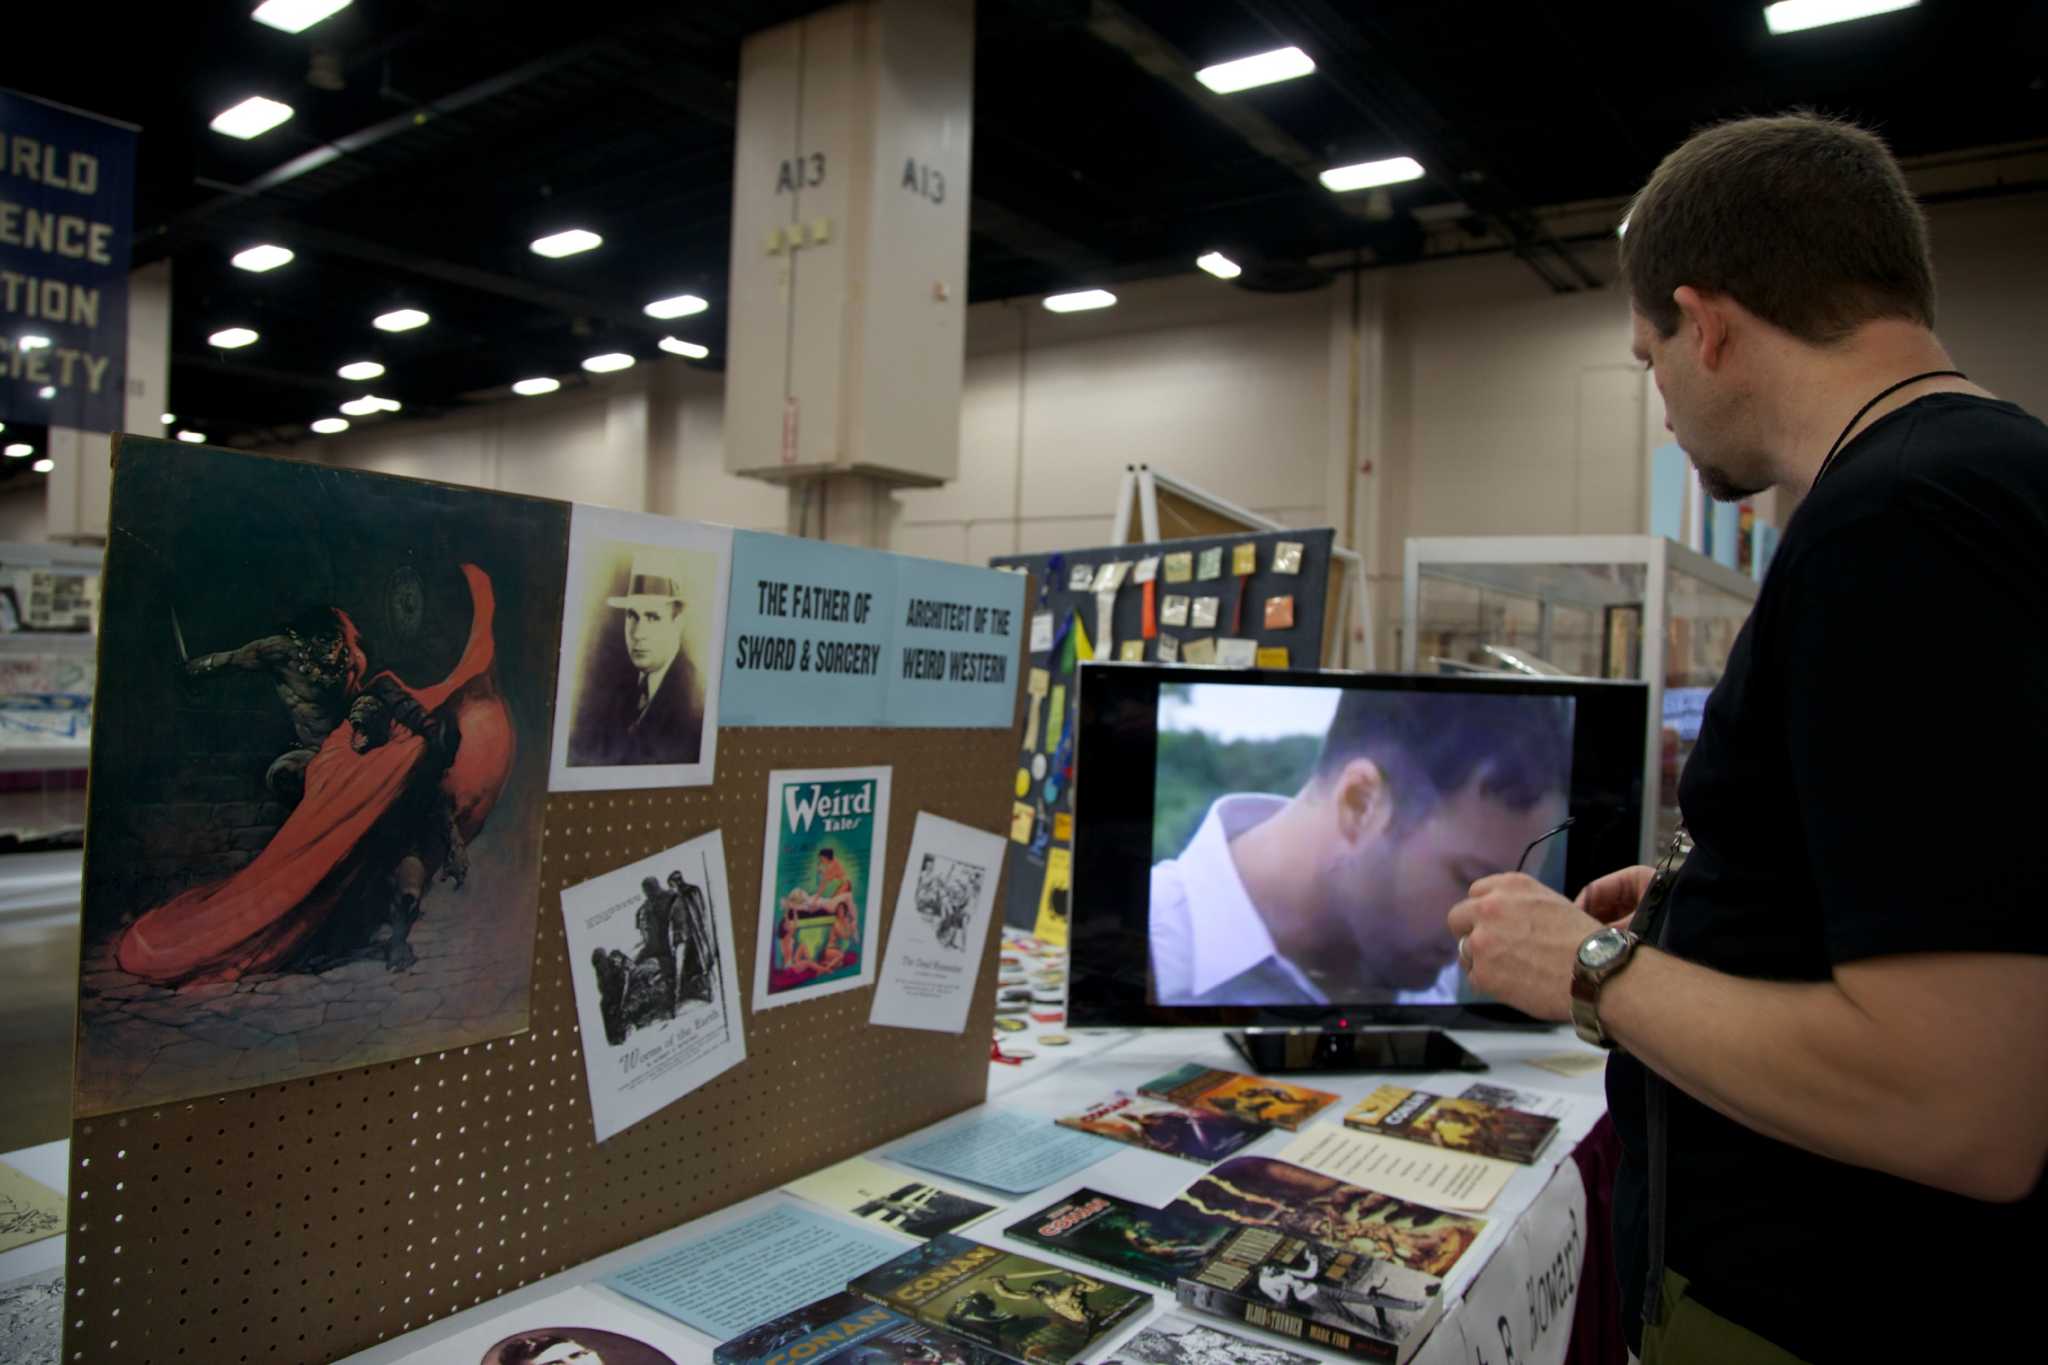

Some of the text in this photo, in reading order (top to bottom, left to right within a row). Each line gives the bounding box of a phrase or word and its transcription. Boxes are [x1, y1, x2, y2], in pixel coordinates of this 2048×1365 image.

[0, 133, 99, 195] RLD
[902, 157, 946, 205] A13
[0, 342, 110, 394] IETY
[758, 580, 873, 625] THE FATHER OF
[906, 598, 1011, 637] ARCHITECT OF THE
[736, 635, 881, 676] SWORD & SORCERY
[902, 648, 1008, 684] WEIRD WESTERN
[784, 782, 872, 834] Weird
[822, 816, 863, 832] Tales
[896, 1244, 998, 1301] CONAN
